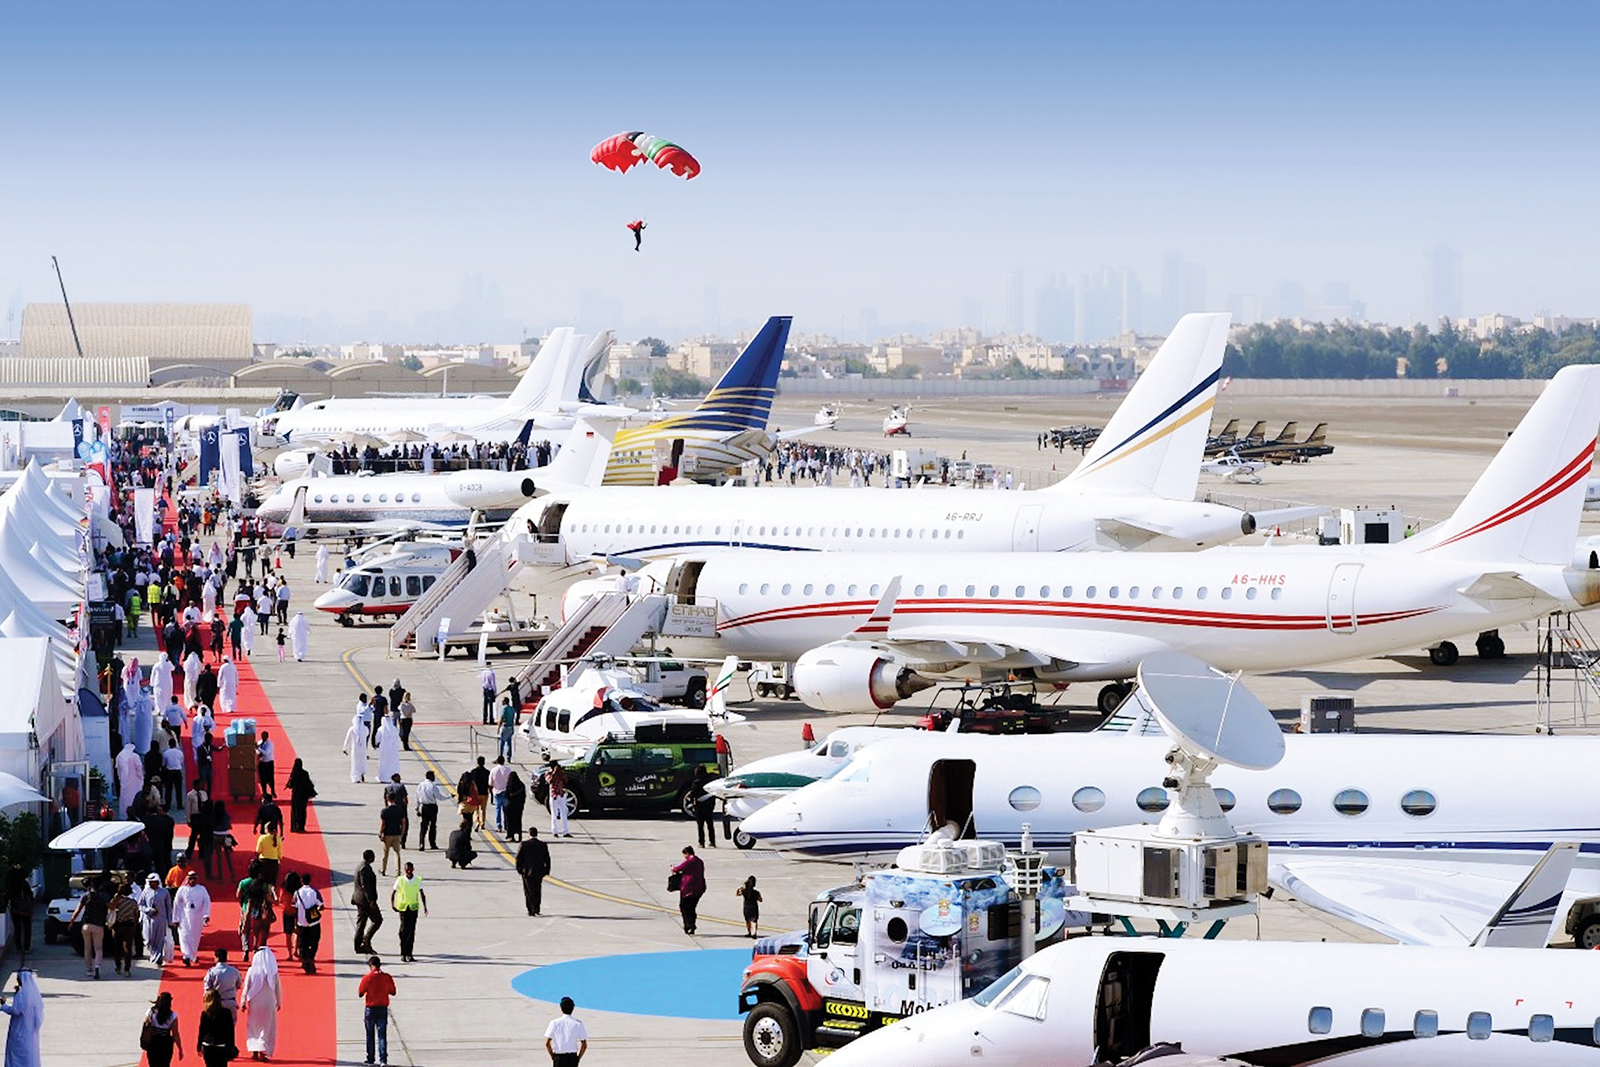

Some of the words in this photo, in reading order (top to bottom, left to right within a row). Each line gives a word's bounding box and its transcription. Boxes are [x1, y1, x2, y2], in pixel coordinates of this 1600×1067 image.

[944, 511, 983, 522] A6-RRJ
[1231, 574, 1287, 586] A6-HHS
[672, 605, 716, 618] ETIHAD
